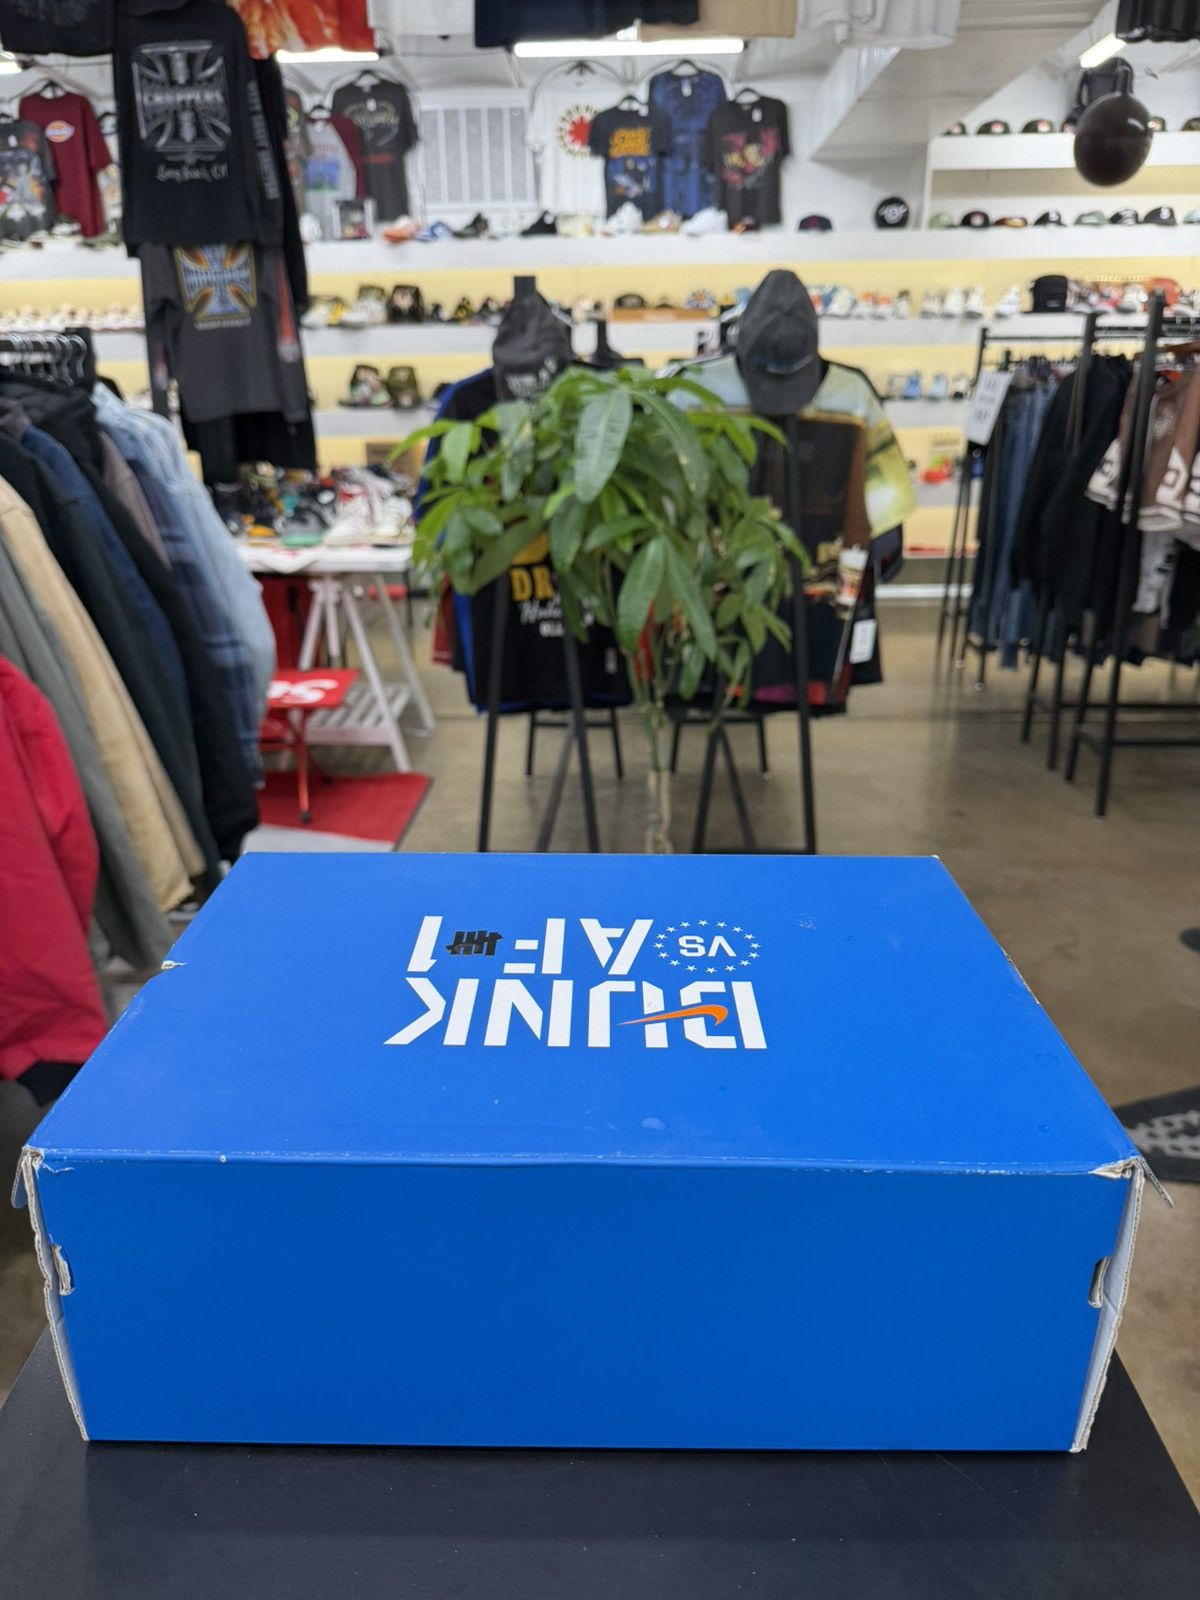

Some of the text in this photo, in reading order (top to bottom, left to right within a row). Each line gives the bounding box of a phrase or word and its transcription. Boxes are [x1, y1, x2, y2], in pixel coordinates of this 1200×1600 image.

[406, 915, 737, 975] VS AF 1
[383, 977, 768, 1050] DUNK
